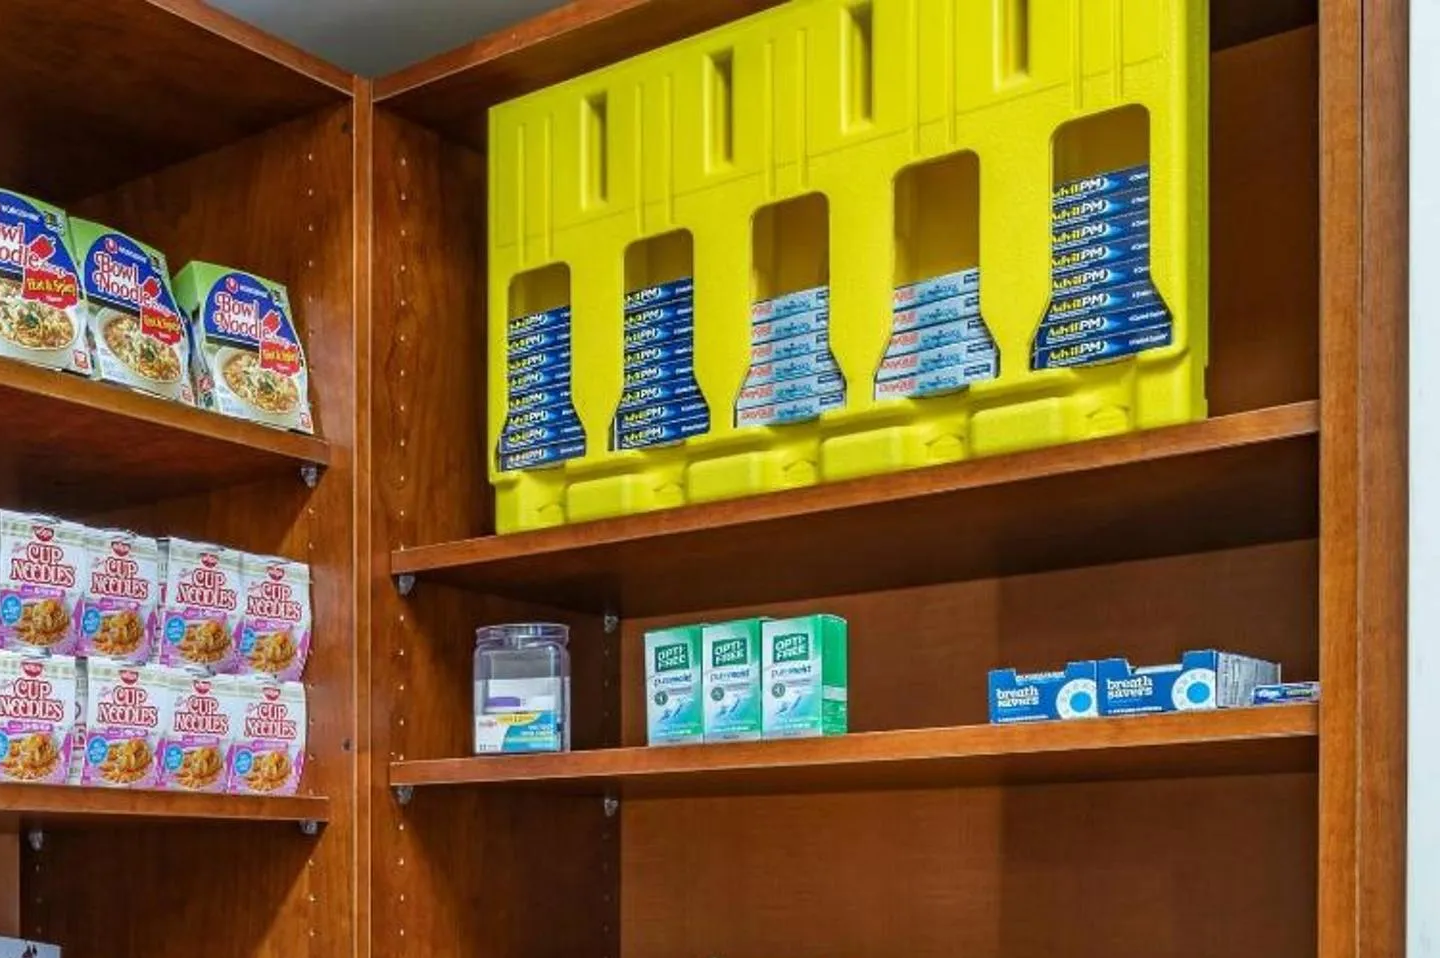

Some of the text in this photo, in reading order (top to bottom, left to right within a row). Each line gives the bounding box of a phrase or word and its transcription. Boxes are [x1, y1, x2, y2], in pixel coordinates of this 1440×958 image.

[94, 252, 138, 287] Bowl
[215, 292, 259, 319] Bowl
[27, 543, 63, 564] CUP
[11, 558, 75, 588] NOODLES
[105, 557, 139, 578] CUP
[91, 572, 149, 599] NOODLES
[192, 569, 226, 590] CUP
[176, 583, 238, 610] NOODLES
[261, 581, 292, 601] CUP
[246, 597, 302, 622] NOODLES
[14, 679, 52, 699] CUP
[996, 685, 1039, 699] breath
[1106, 675, 1153, 690] breath
[113, 686, 147, 707] CUP
[188, 696, 219, 716] CUP
[97, 703, 158, 727] NOODLES
[258, 703, 288, 722] CUP
[174, 713, 229, 735] NOODLES
[244, 718, 297, 740] NOODLES
